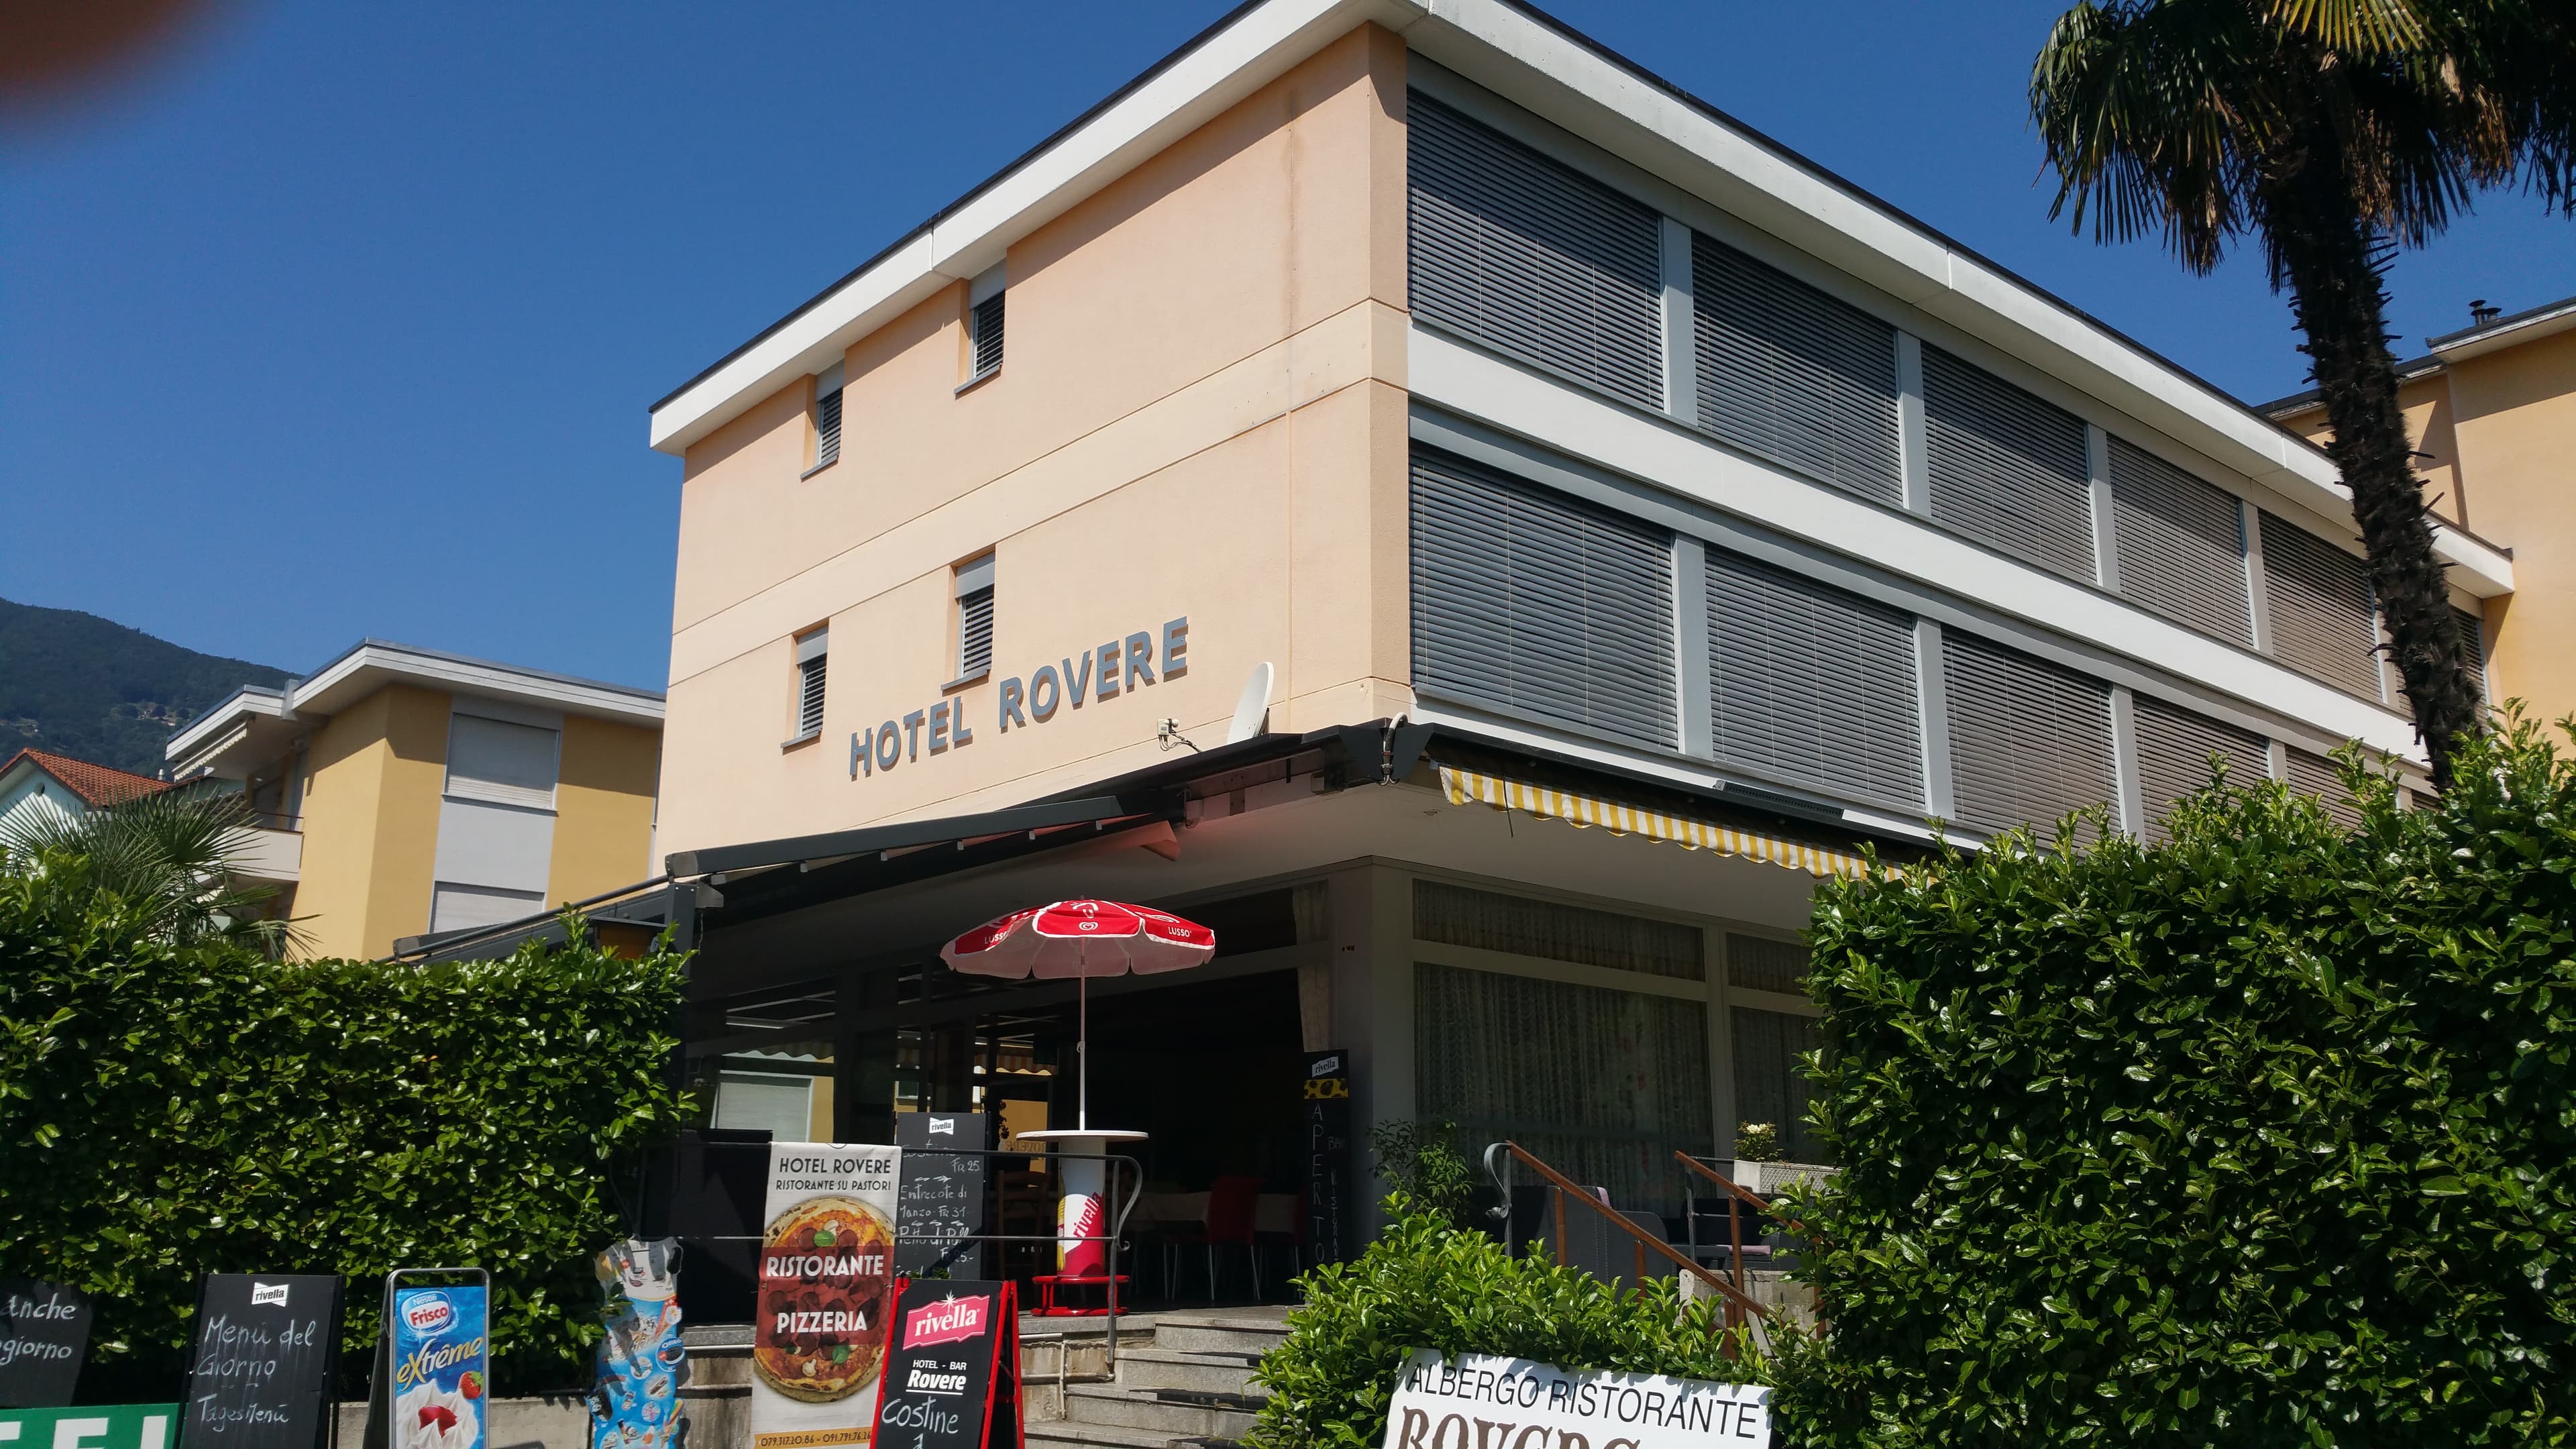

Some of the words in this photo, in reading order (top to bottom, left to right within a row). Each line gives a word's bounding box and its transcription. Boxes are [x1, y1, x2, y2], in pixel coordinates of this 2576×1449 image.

[849, 696, 973, 780] HOTEL
[999, 615, 1188, 731] ROVERE
[1168, 926, 1190, 937] LUSSO
[1315, 1059, 1336, 1074] rivella
[931, 1121, 952, 1131] rivella
[779, 1158, 827, 1173] HOTEL
[833, 1159, 892, 1174] ROVERE
[775, 1179, 835, 1190] RISTORANTE
[837, 1180, 848, 1190] SU
[851, 1180, 891, 1191] PASTORI
[958, 1184, 967, 1199] di
[1073, 1191, 1101, 1239] rivella
[765, 1255, 885, 1278] RISTORANTE
[255, 1288, 285, 1301] rivella
[409, 1306, 448, 1326] Frisco
[776, 1310, 867, 1334] PIZZERIA
[914, 1303, 977, 1337] rivella
[278, 1318, 317, 1350] del
[0, 1335, 72, 1366] giorno
[912, 1359, 938, 1369] HOTEL
[949, 1361, 967, 1371] BAR
[907, 1369, 967, 1391] Rovere
[1409, 1362, 1540, 1408] ALBERGO
[1548, 1379, 1760, 1439] RISTORANTE
[881, 1395, 959, 1434] Costine
